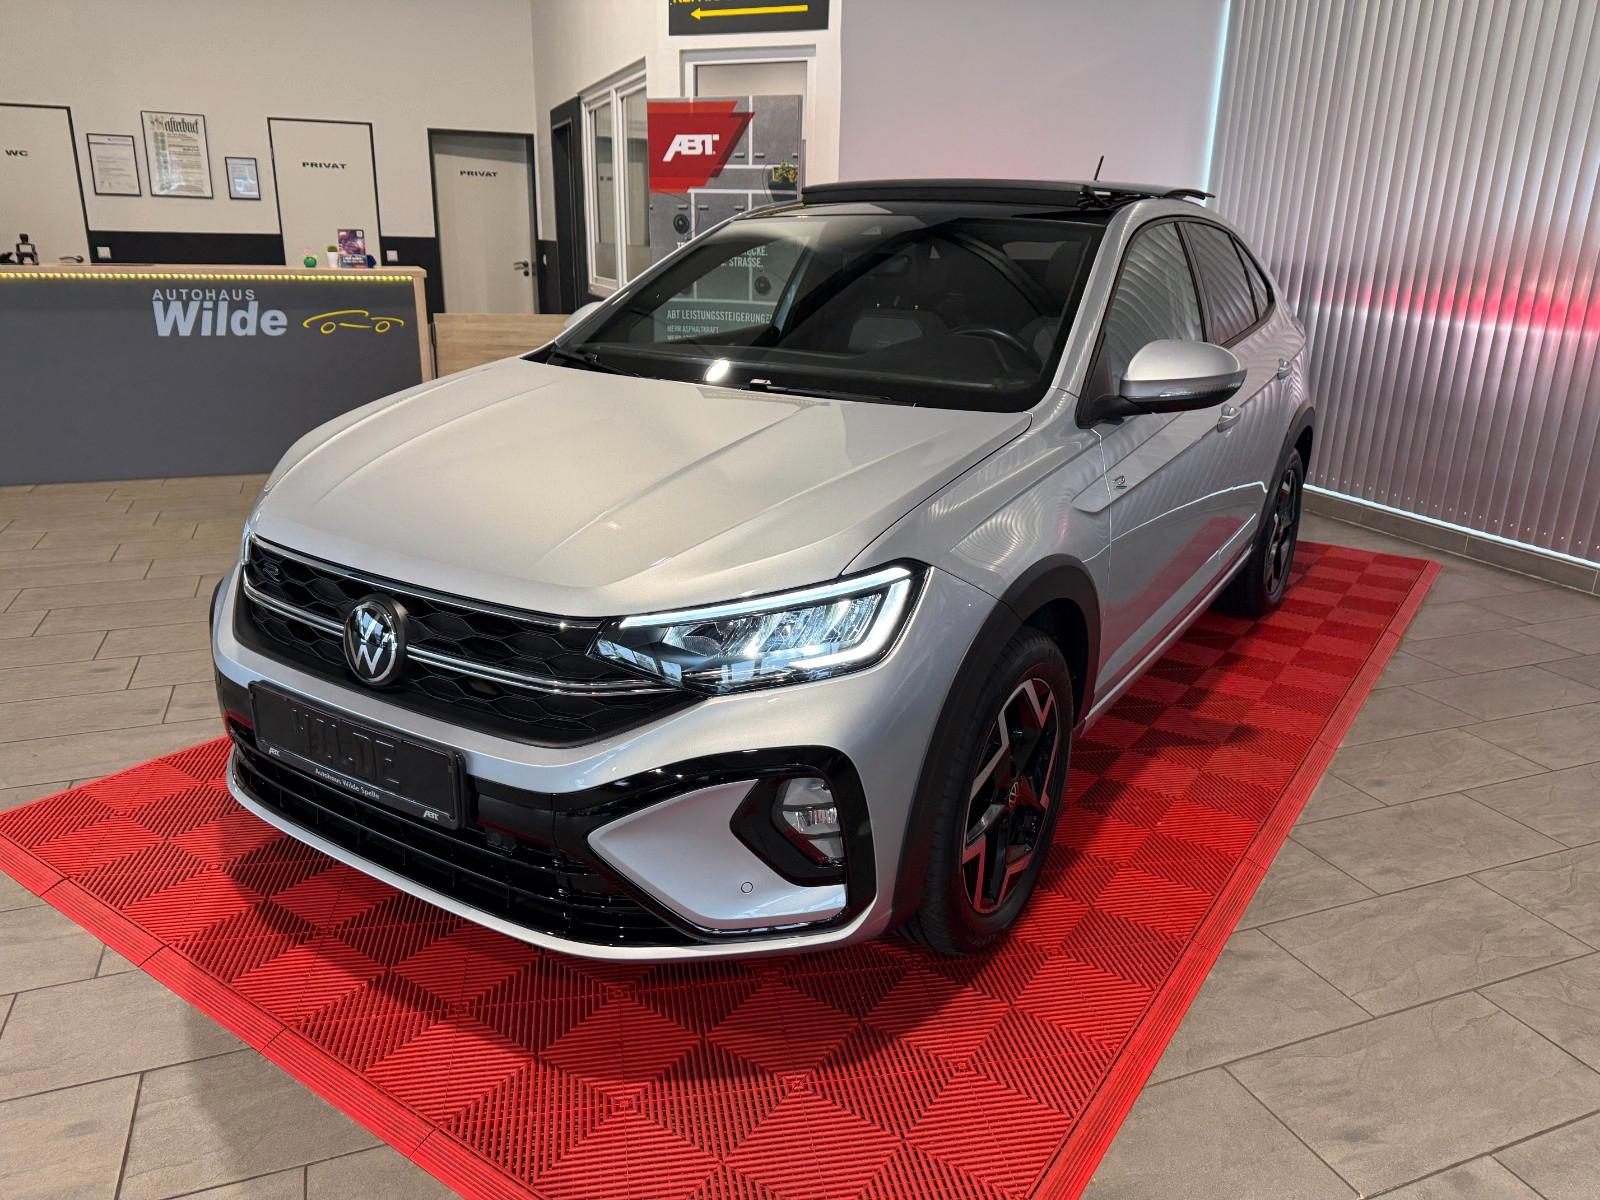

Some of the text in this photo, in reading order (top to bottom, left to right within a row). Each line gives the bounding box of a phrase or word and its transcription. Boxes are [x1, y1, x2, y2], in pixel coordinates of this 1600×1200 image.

[662, 134, 720, 162] ABT
[302, 161, 347, 170] PRIVAT
[459, 169, 499, 178] PRIVAT
[152, 289, 256, 301] AUTOHAUS
[152, 301, 288, 337] Wilde
[667, 309, 681, 319] ABT
